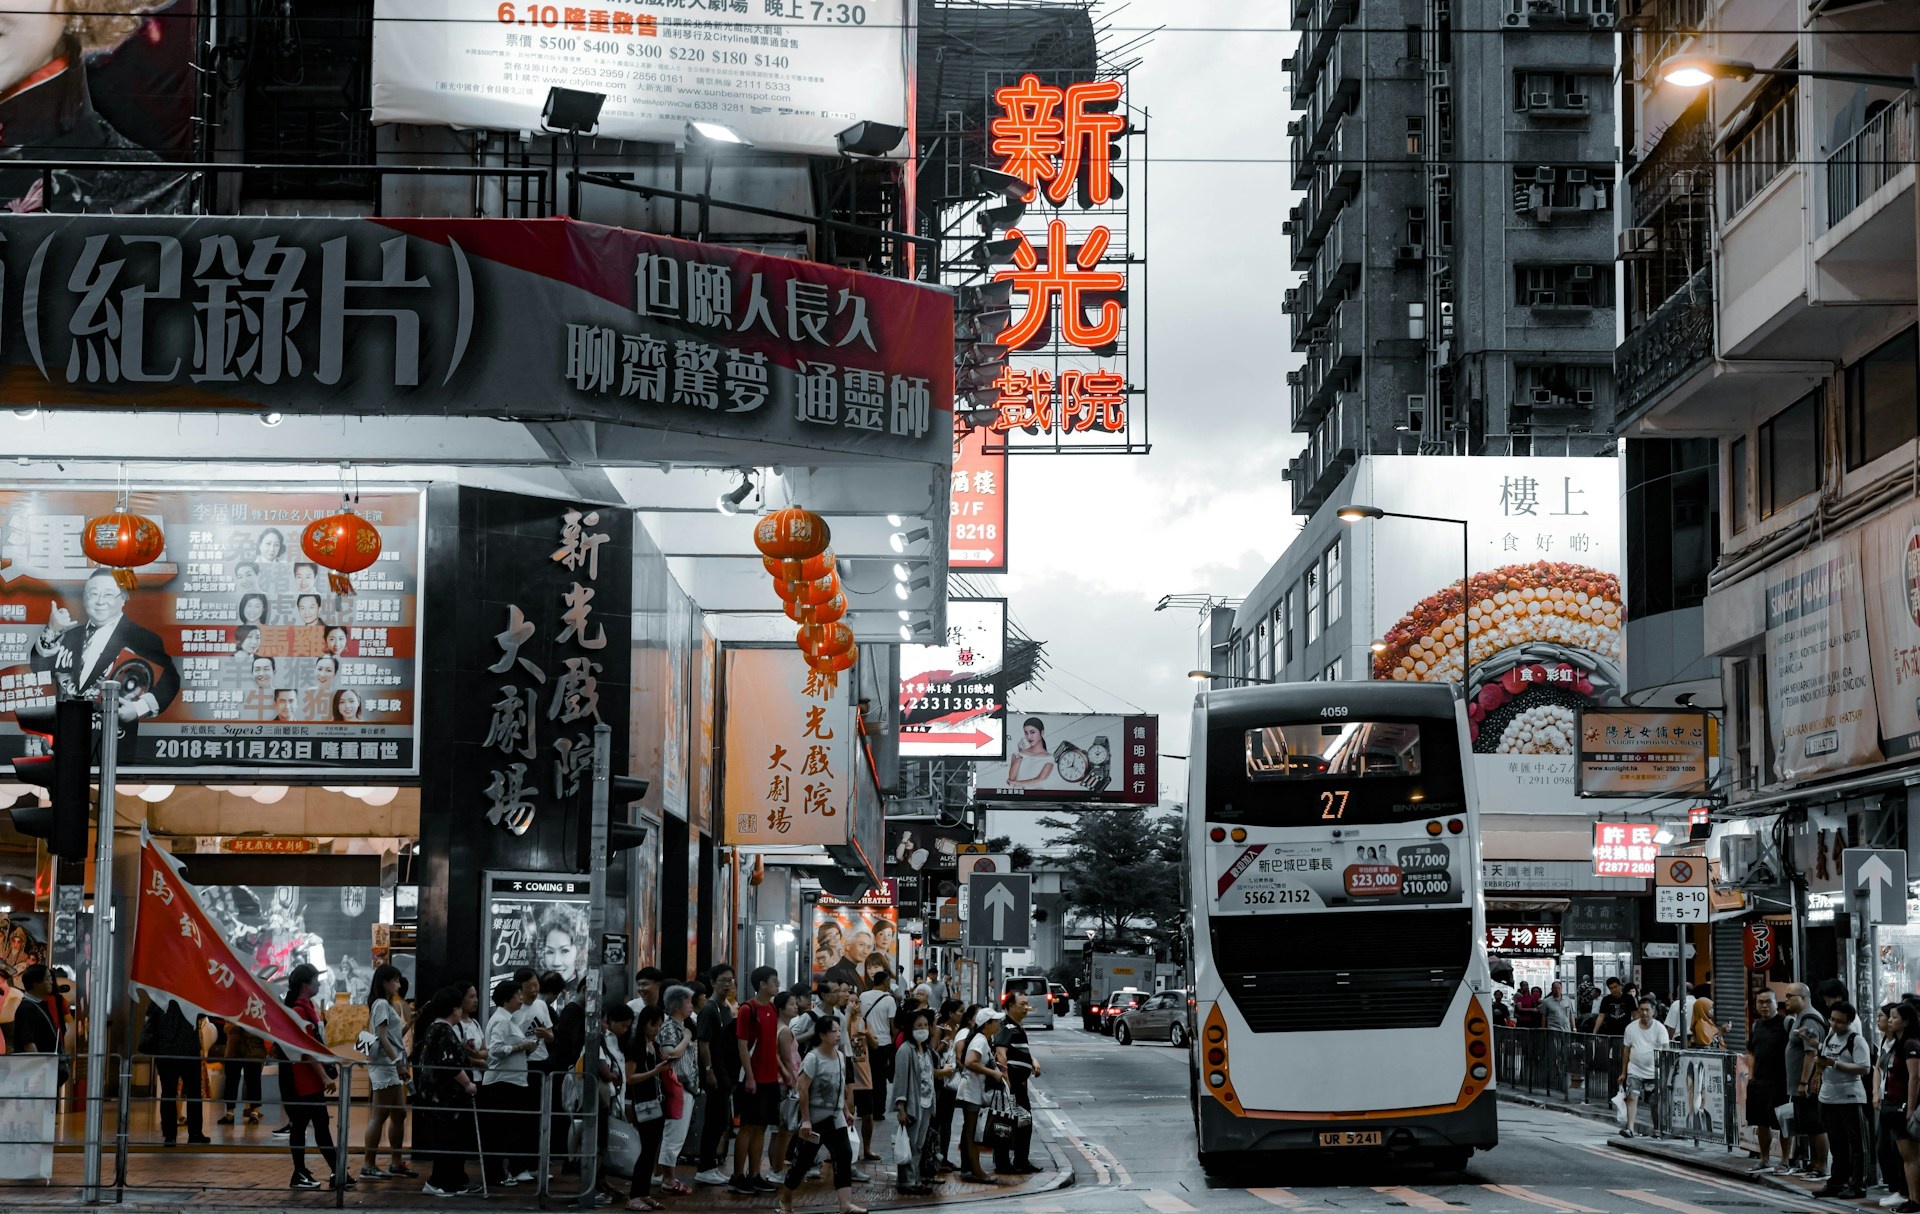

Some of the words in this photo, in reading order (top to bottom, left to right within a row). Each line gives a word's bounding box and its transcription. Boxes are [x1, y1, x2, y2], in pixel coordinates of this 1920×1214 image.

[497, 1, 559, 28] 6.10
[564, 7, 658, 38] 隆重發售
[810, 1, 866, 25] 7:30
[505, 33, 533, 49] 票價
[583, 39, 619, 55] $400
[626, 43, 662, 59] $300
[669, 46, 705, 62] $220
[712, 51, 747, 66] $180
[754, 53, 789, 69] $140
[572, 66, 597, 76] 2563
[600, 68, 624, 79] 2959
[633, 72, 657, 81] 2856
[660, 74, 684, 83] 0161
[736, 79, 761, 89] 2111
[765, 81, 791, 92] 5333
[543, 76, 627, 89] www.cityline.com
[678, 87, 791, 102] www.sunbeamspot.com
[694, 101, 719, 111] 6338
[722, 103, 745, 113] 3281
[634, 252, 878, 353] 但願人長久
[565, 322, 770, 414] 聊齋驚夢
[795, 359, 931, 439] 通靈師
[1499, 475, 1589, 517] 樓上
[955, 523, 997, 540] 8218
[909, 697, 995, 711] 23313838
[1320, 706, 1349, 717] 4059
[1605, 725, 1703, 739] 陽光女傭中心
[155, 739, 312, 760] 2018年11月23日
[320, 741, 399, 760] 隆重面世
[1588, 765, 1638, 773] www.sunlight.hk
[1528, 776, 1550, 785] 2911
[767, 744, 792, 835] 大劇場
[1320, 790, 1350, 819] 27
[1392, 803, 1442, 813] ENVIRO
[1258, 857, 1333, 873] 新巴城巴車長
[525, 882, 563, 892] COMING
[819, 896, 856, 904] SUNB
[1244, 890, 1275, 905] 5562
[1279, 889, 1310, 904] 2152
[1659, 895, 1674, 903] 上午
[1676, 891, 1706, 902] 8-10
[1659, 912, 1675, 920] 下午
[1751, 922, 1771, 968] ラーメン
[1324, 1133, 1341, 1145] UR
[1347, 1133, 1378, 1145] 5241
